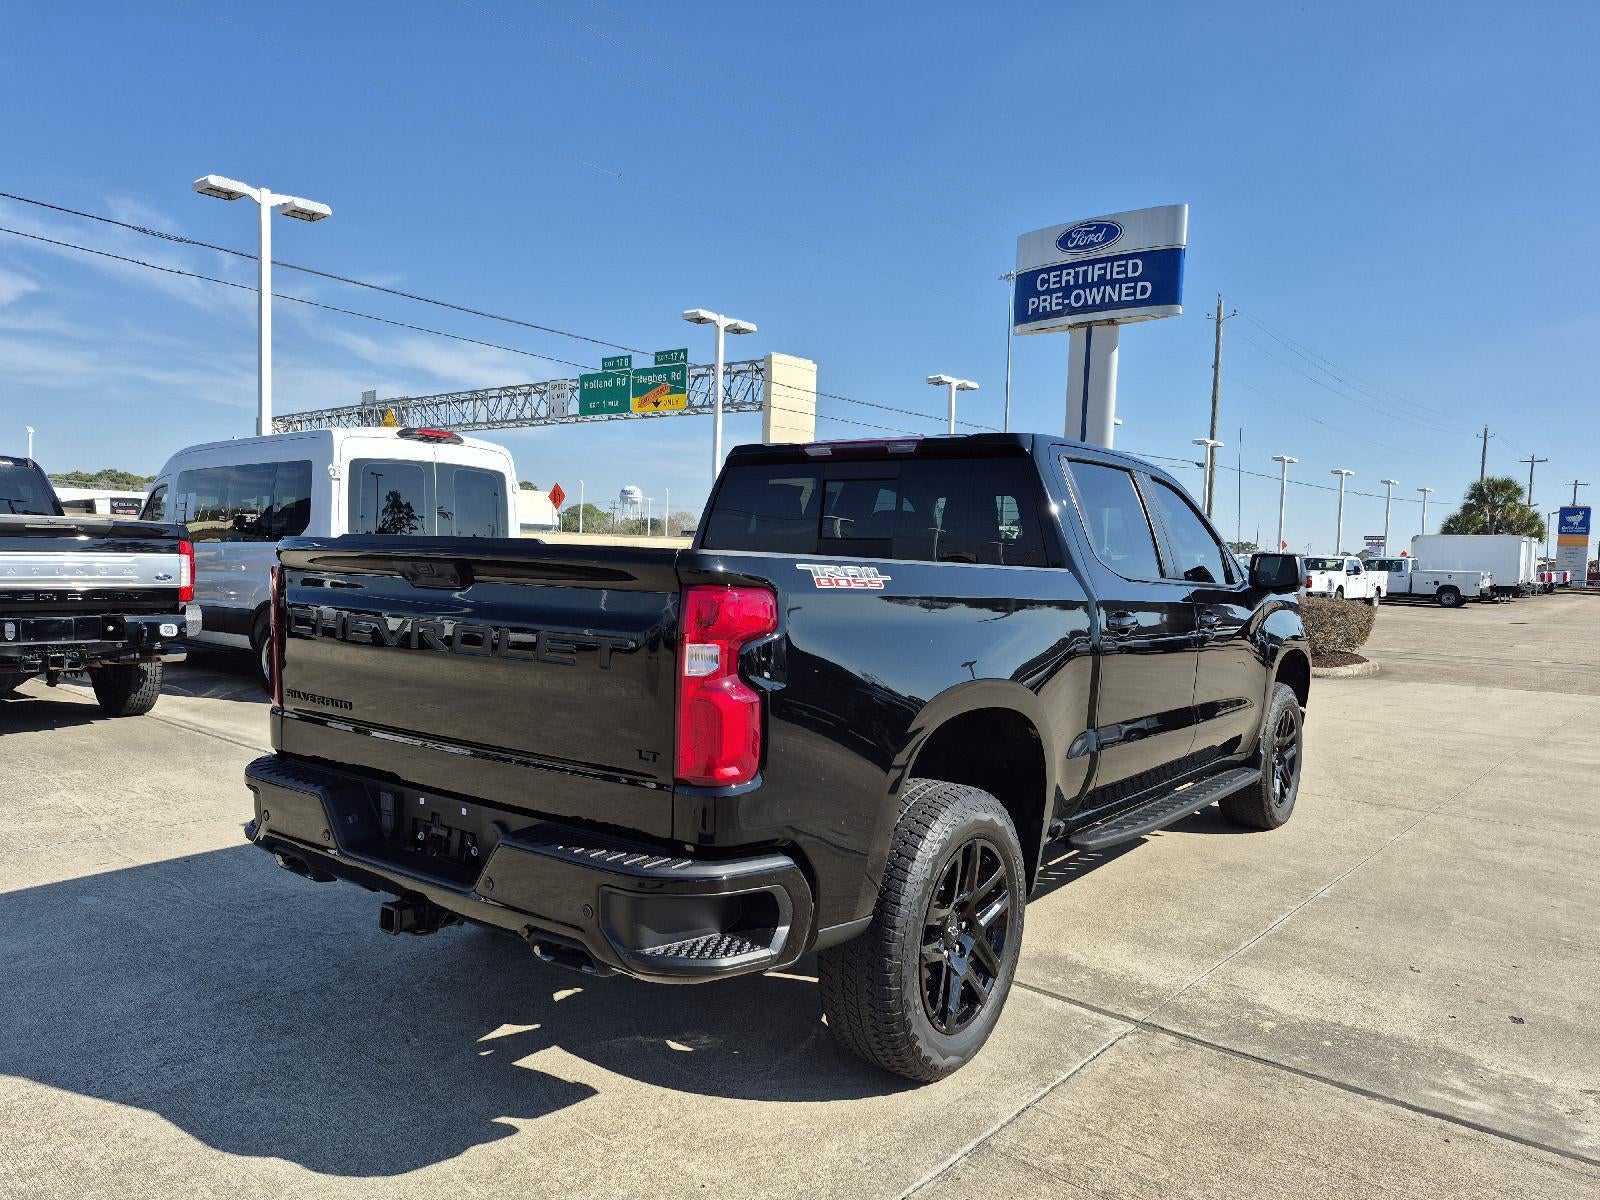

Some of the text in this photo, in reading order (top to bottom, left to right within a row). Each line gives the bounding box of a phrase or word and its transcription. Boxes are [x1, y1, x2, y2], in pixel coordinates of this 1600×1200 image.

[1067, 225, 1107, 248] Ford
[1036, 258, 1143, 291] CERTIFIED
[1027, 281, 1152, 315] PRE-OWNED
[679, 352, 685, 360] A
[584, 376, 626, 390] Holland Rd
[637, 370, 682, 385] Hughes Rd
[551, 383, 567, 391] SPEED
[795, 563, 892, 581] TRAIL
[814, 577, 885, 590] BOSS
[288, 606, 636, 670] CHEVROLET
[286, 688, 353, 711] SILVERADO
[635, 749, 661, 763] LT
